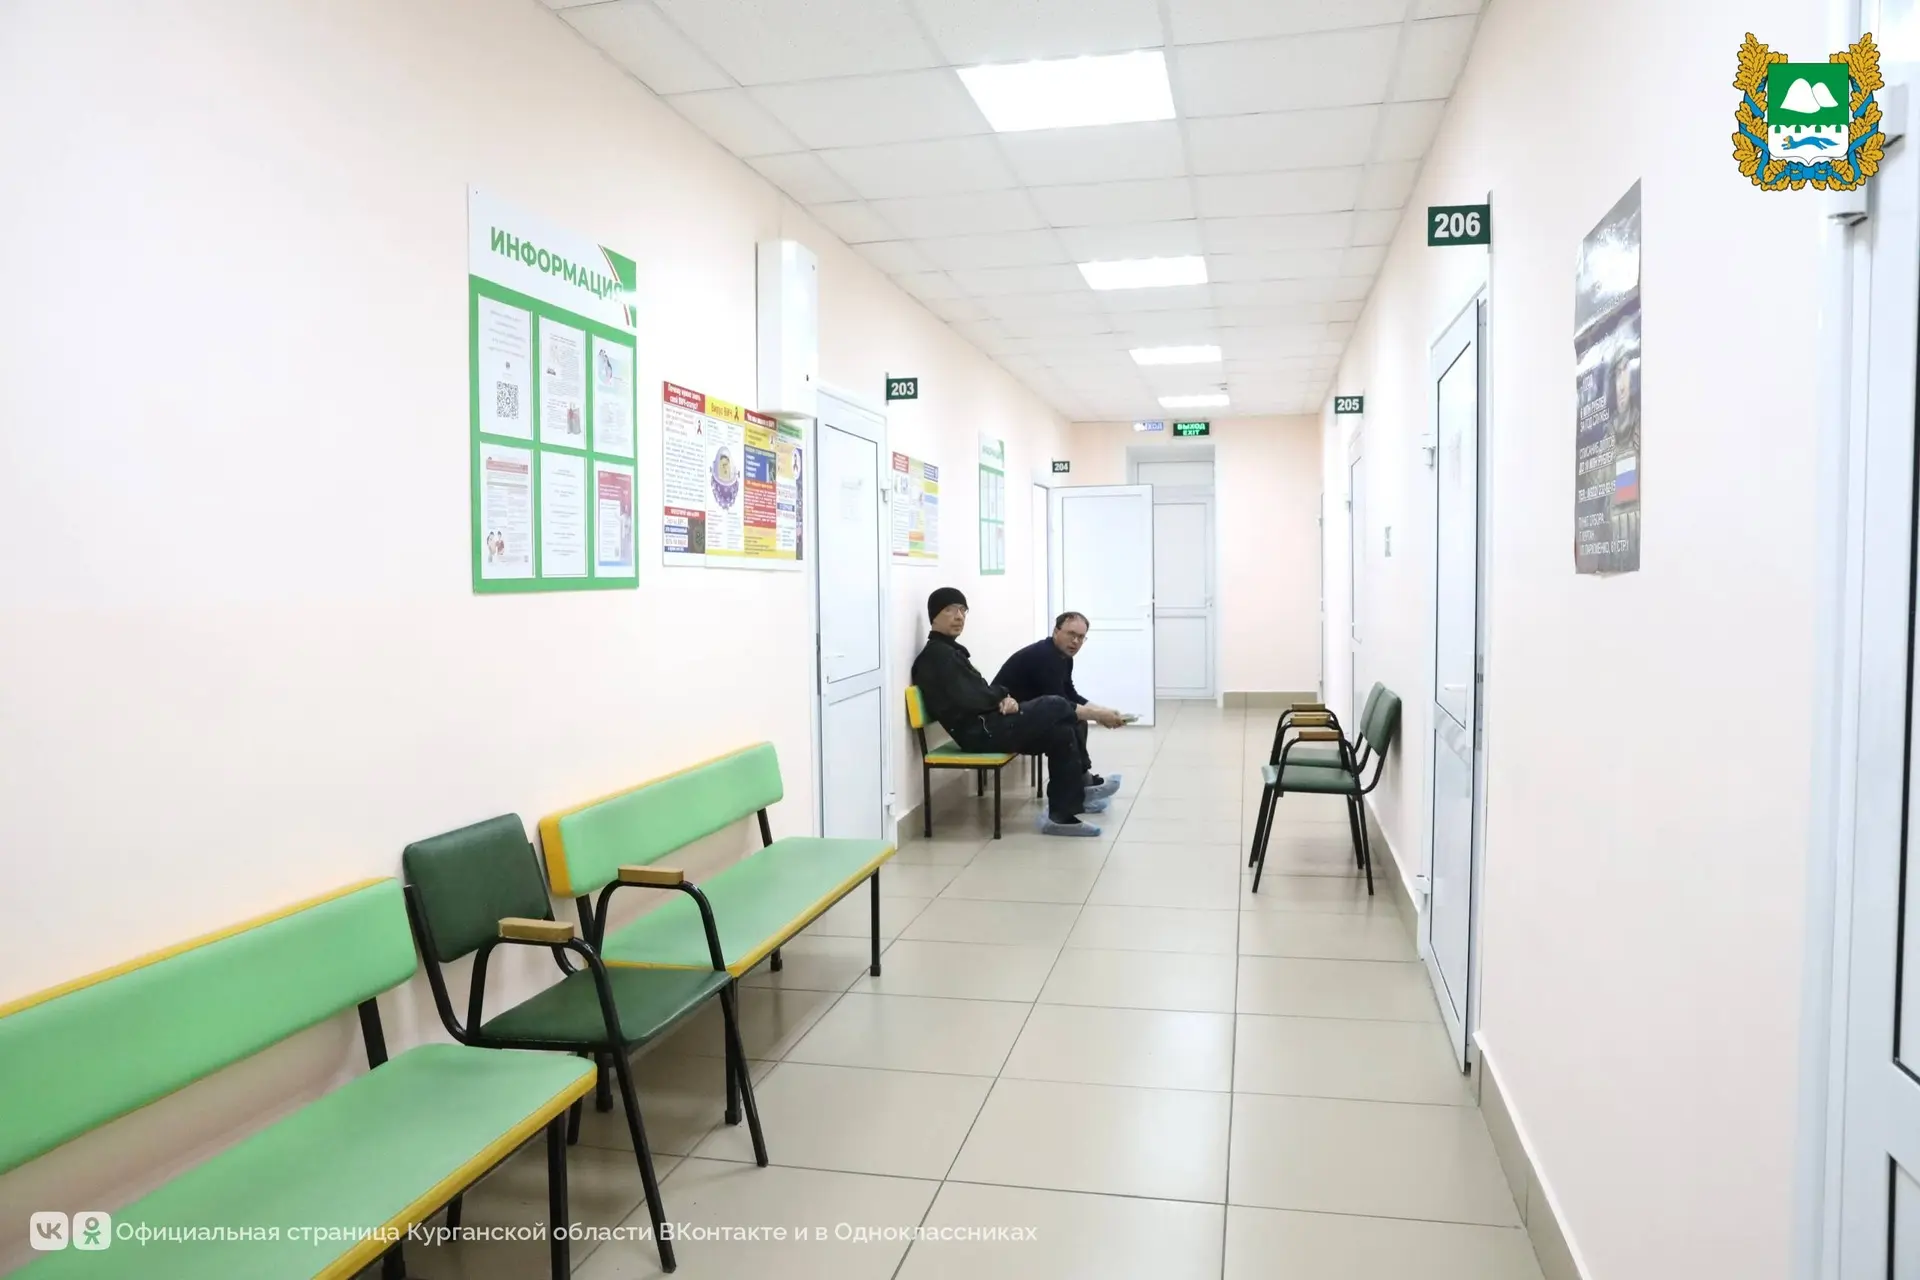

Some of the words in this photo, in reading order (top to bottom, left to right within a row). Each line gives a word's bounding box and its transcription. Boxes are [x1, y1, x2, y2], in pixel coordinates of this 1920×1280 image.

[1434, 211, 1481, 238] 206
[491, 226, 623, 303] ИНФОРМАЦИЯ
[891, 382, 915, 396] 203
[1337, 398, 1360, 411] 205
[724, 406, 733, 418] ВИЧ
[1054, 462, 1069, 471] 204
